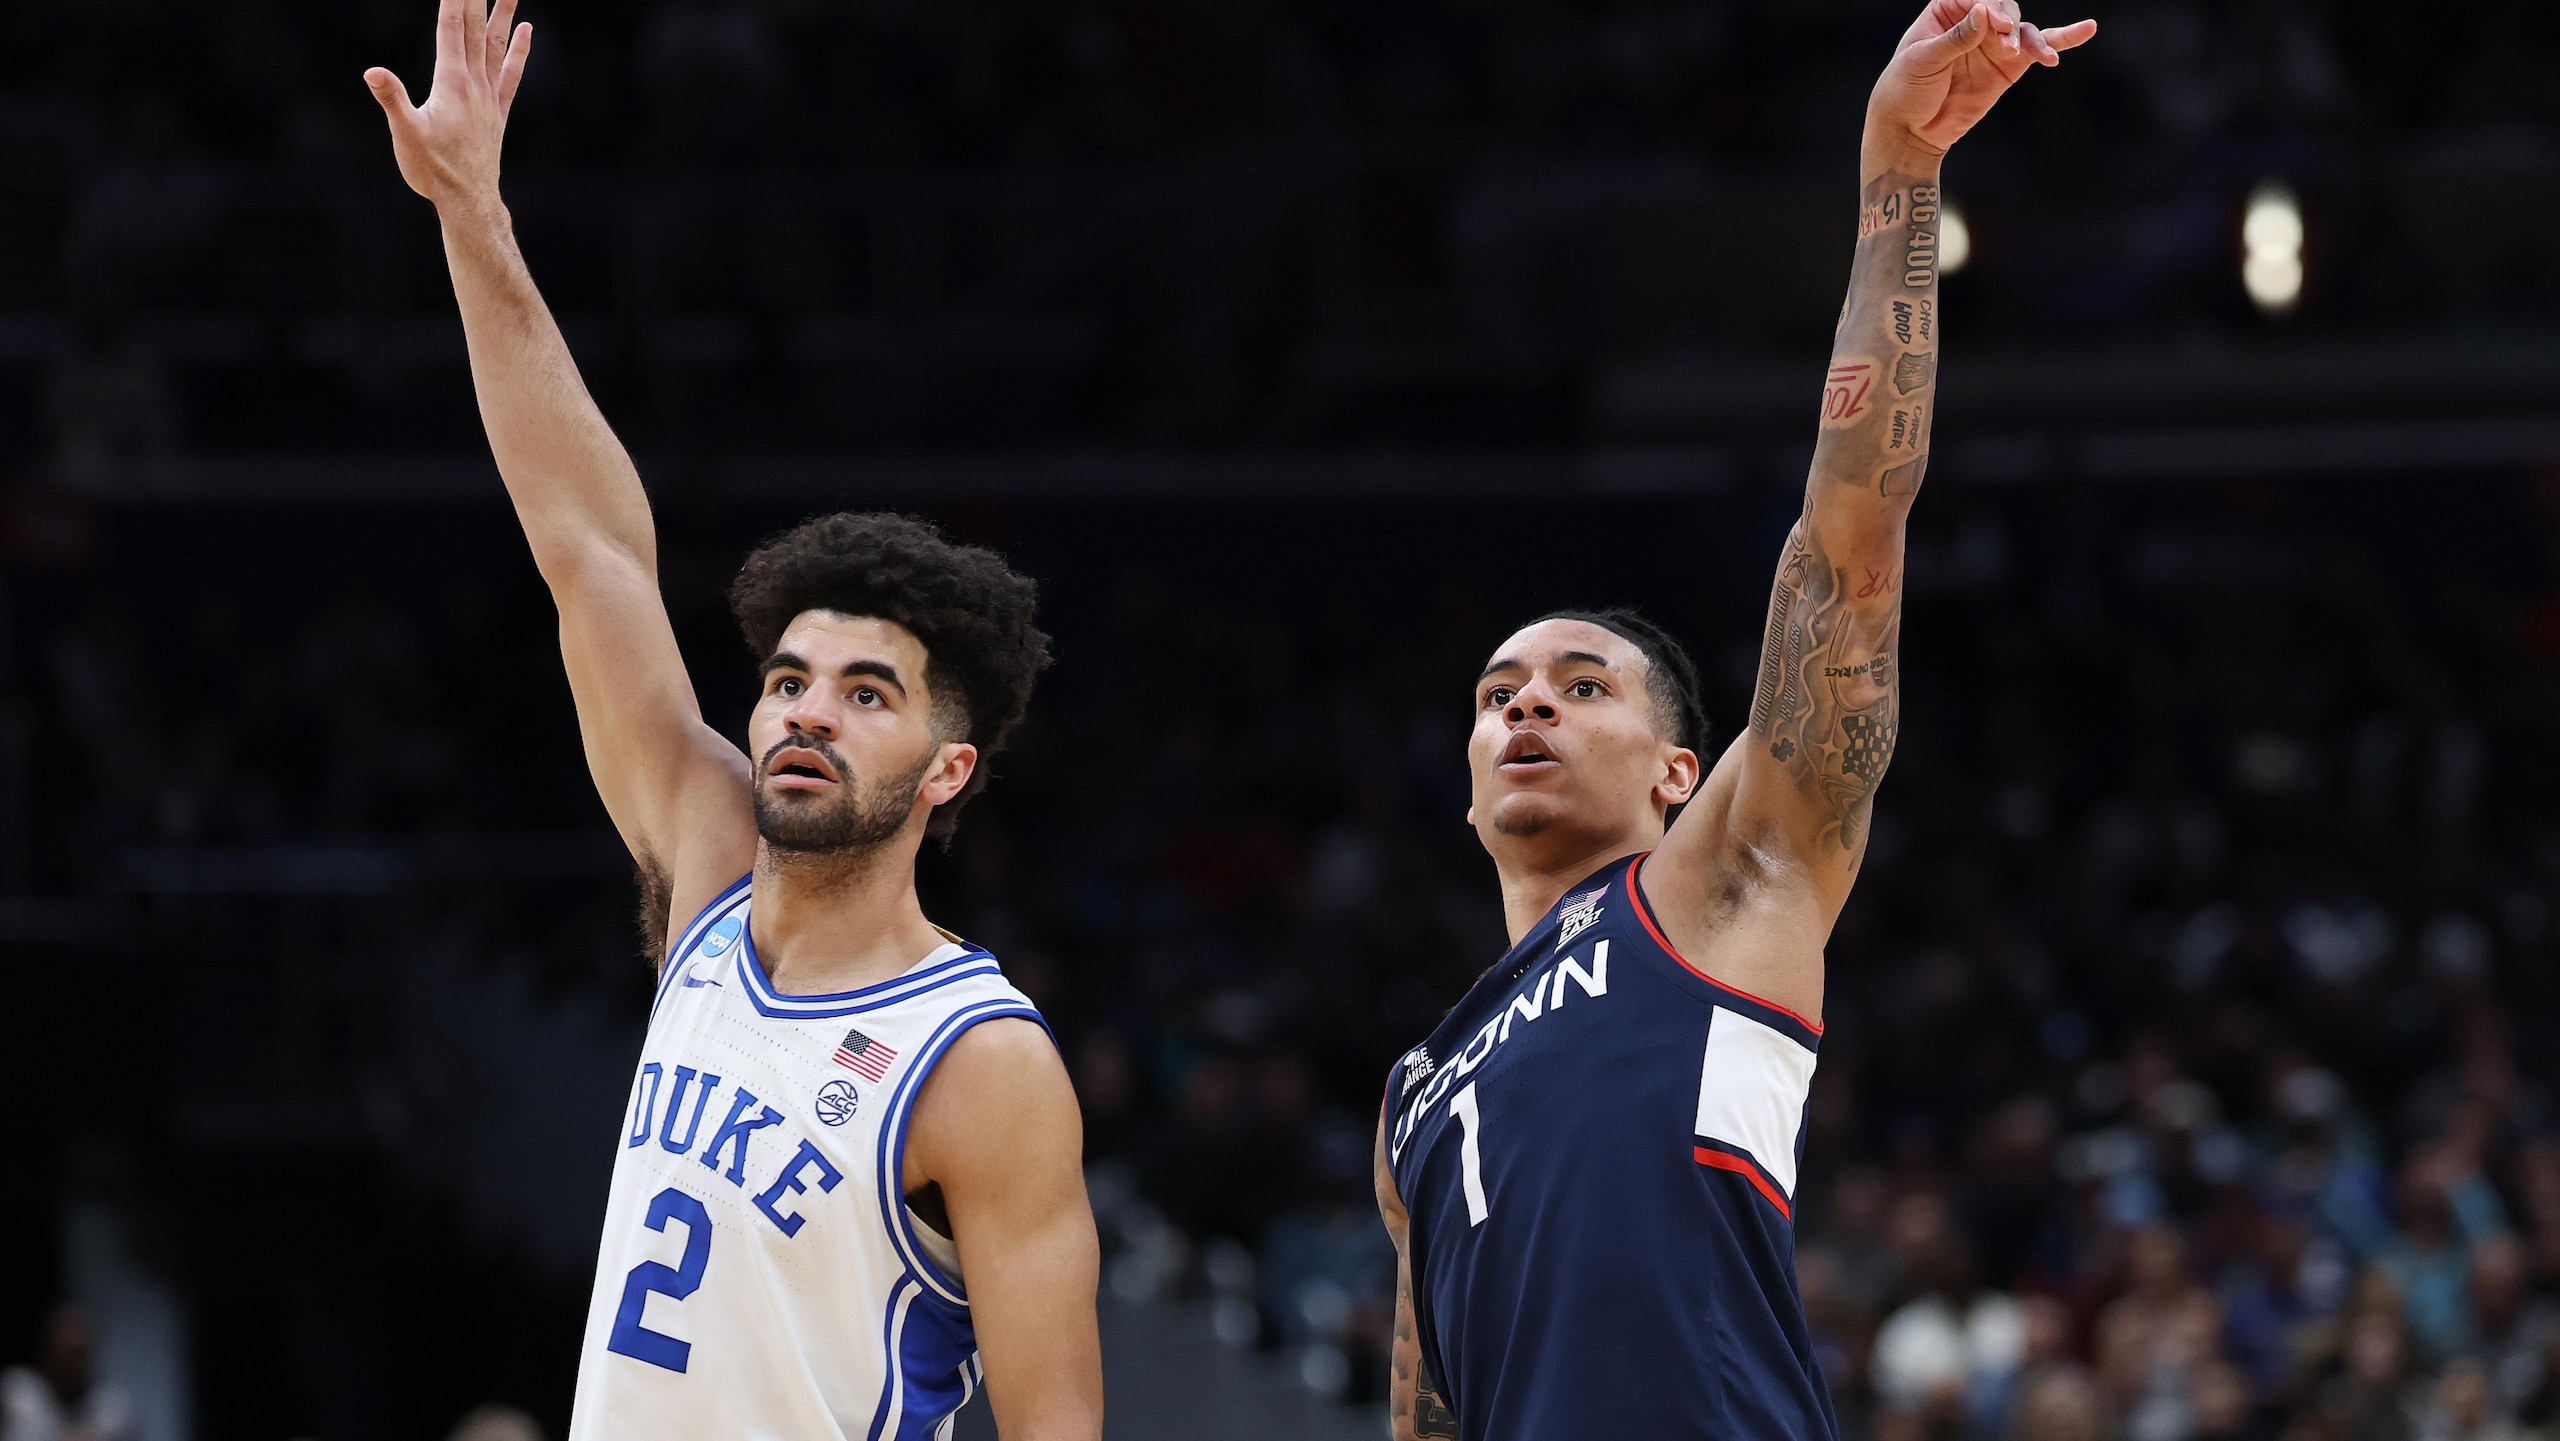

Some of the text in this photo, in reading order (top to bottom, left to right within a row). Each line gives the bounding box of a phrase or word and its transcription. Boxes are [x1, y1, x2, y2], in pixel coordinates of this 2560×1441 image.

[1904, 186, 1938, 288] 86,400
[1893, 300, 1912, 345] WOOD
[1919, 299, 1932, 340] CHOP
[1889, 410, 1908, 449] WATER
[1558, 907, 1605, 944] EAST
[1562, 902, 1597, 930] BIG
[1391, 939, 1610, 1167] UCONN
[823, 1093, 857, 1112] ACC
[628, 1062, 843, 1239] DUKE
[1448, 1080, 1488, 1227] 1
[607, 1187, 713, 1374] 2
